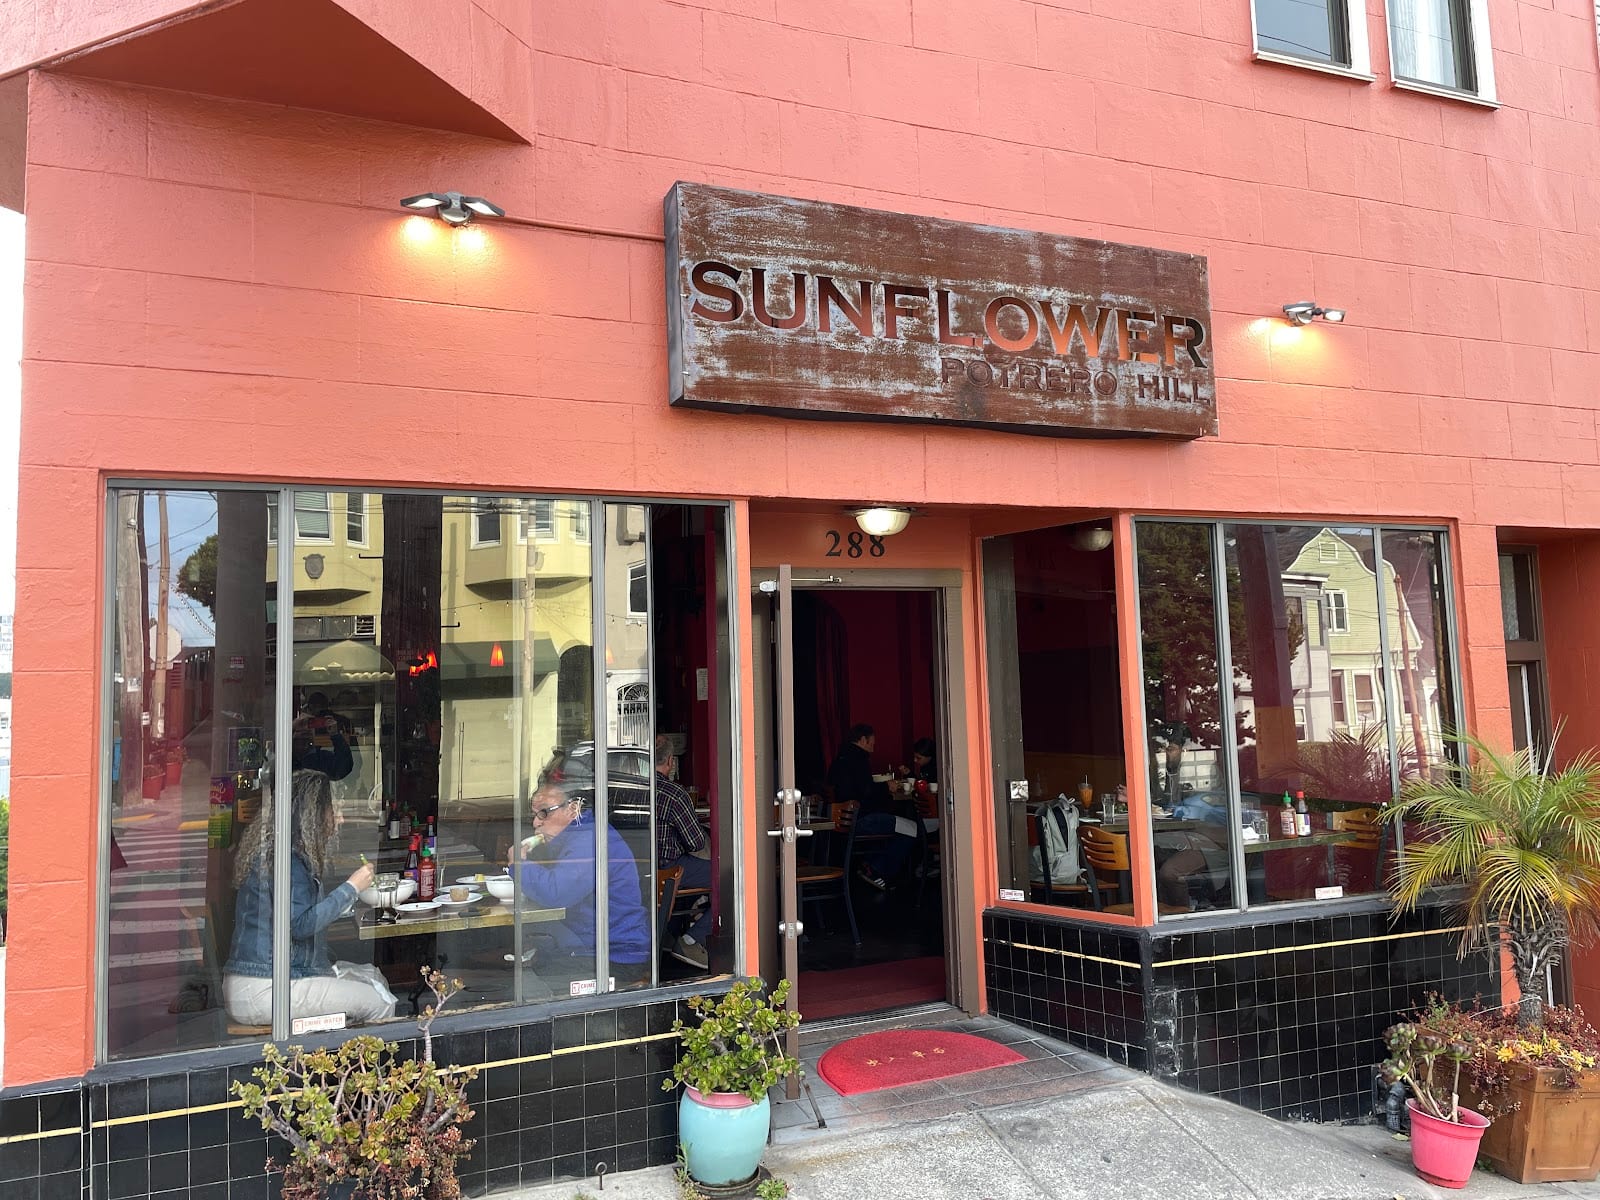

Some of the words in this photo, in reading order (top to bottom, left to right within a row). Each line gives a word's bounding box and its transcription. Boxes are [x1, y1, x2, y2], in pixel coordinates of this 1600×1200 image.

[690, 260, 1208, 369] SUNFLOWER
[940, 356, 1118, 396] POTRERO
[1137, 373, 1211, 405] HILL
[825, 529, 885, 558] 288
